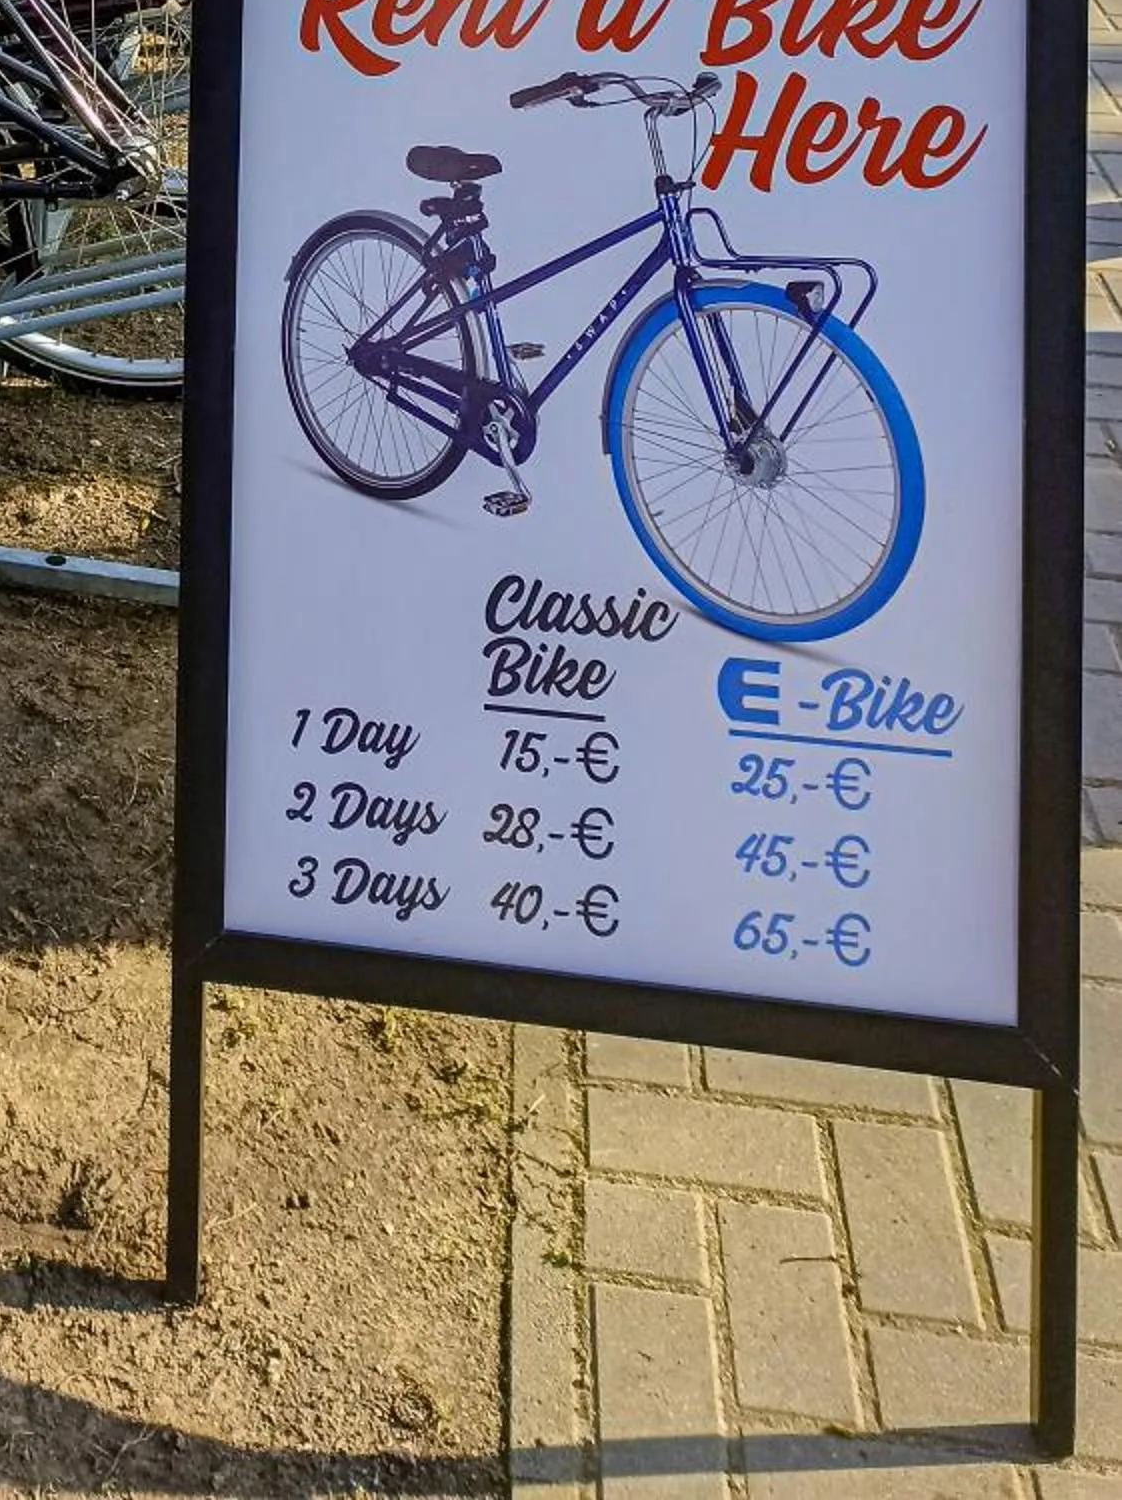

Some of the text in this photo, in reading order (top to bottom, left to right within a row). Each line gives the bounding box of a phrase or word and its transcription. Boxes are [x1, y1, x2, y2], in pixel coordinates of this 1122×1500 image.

[701, 70, 988, 192] Here
[485, 574, 679, 642] Classic
[483, 636, 616, 701] Bike
[291, 708, 311, 749] 1
[321, 708, 420, 770] Day
[286, 781, 316, 823] 2
[329, 782, 446, 846] Days
[288, 855, 319, 899] 3
[332, 857, 450, 921] Days
